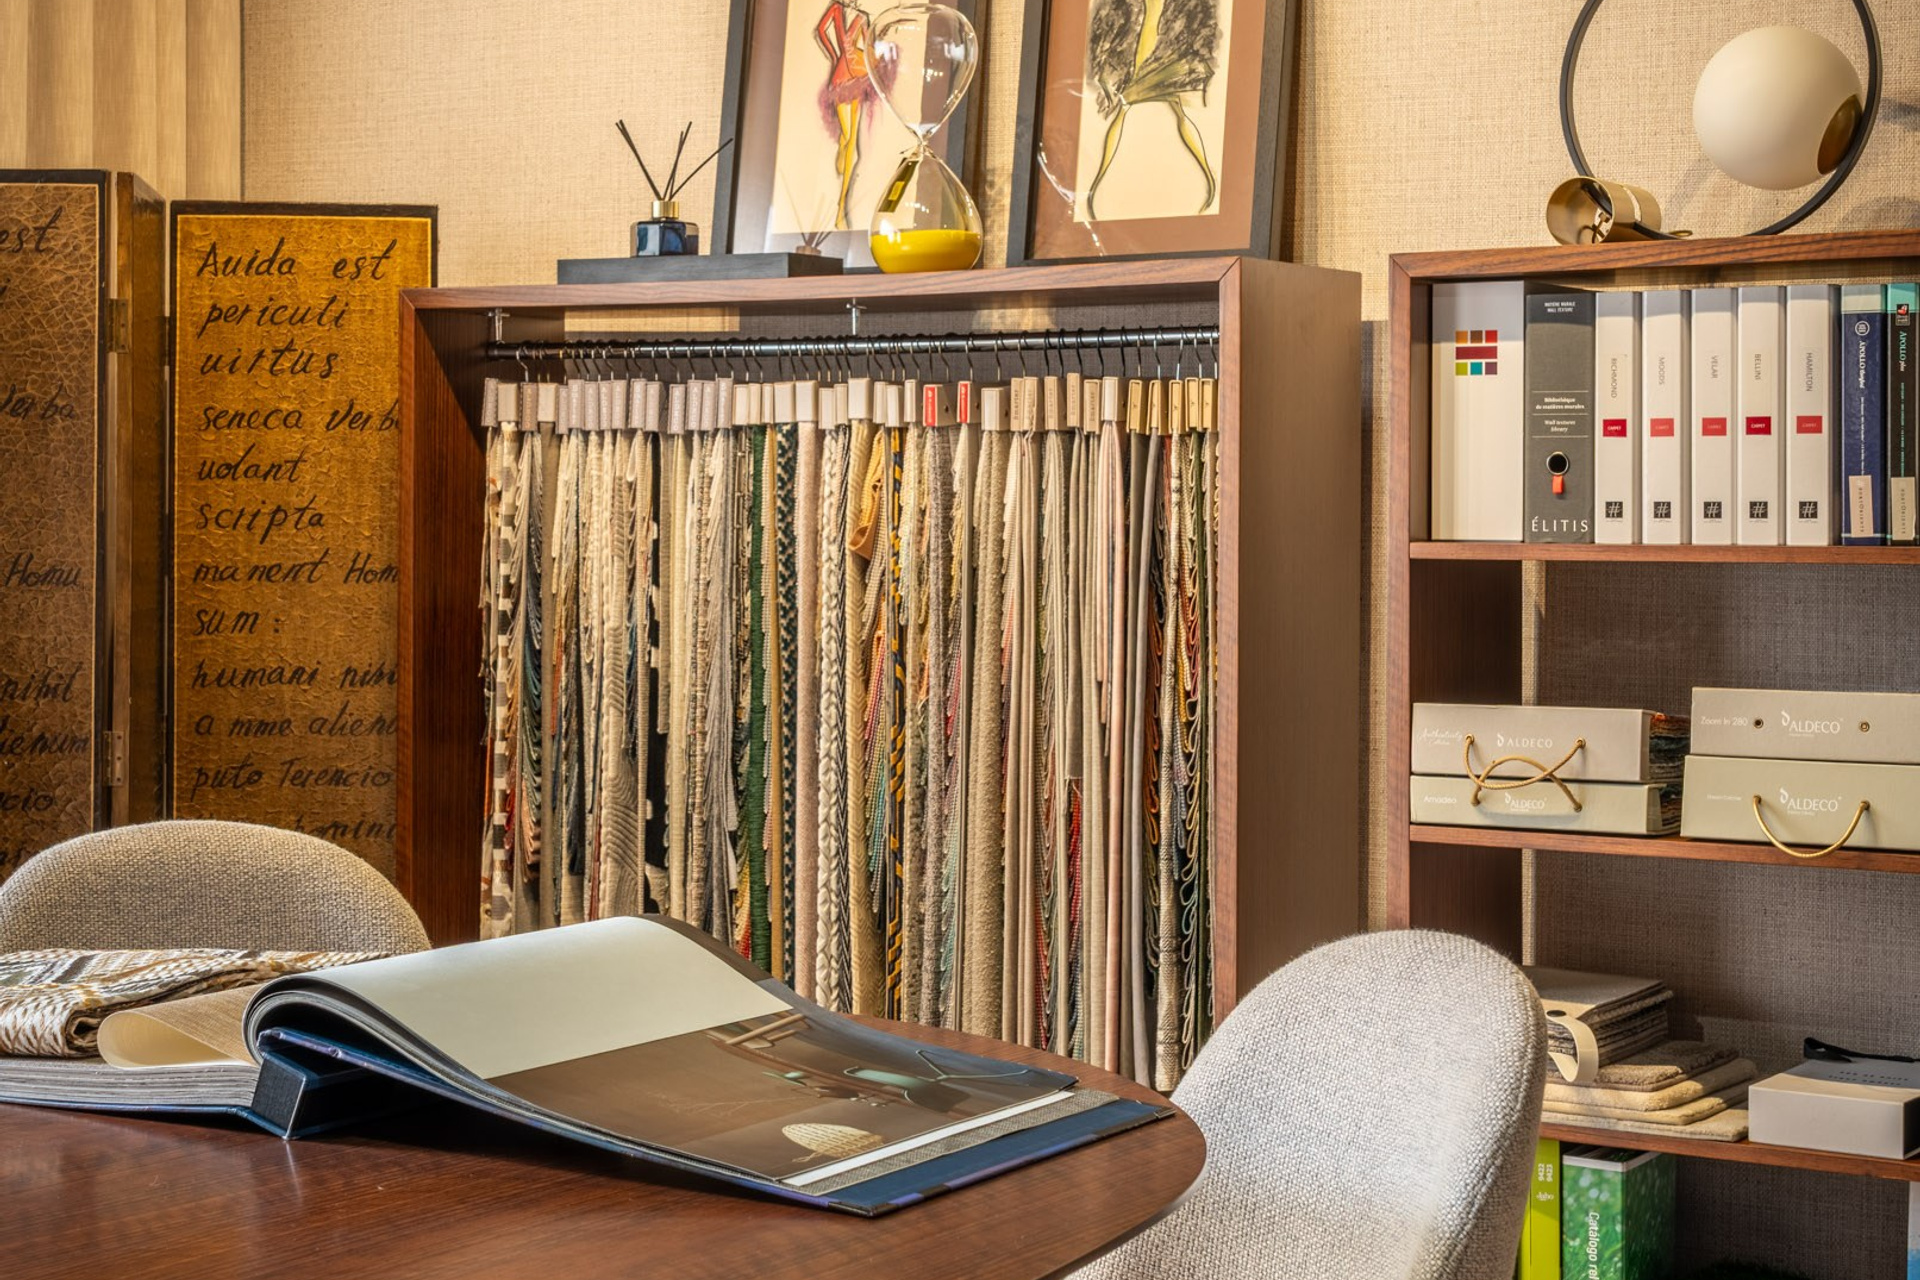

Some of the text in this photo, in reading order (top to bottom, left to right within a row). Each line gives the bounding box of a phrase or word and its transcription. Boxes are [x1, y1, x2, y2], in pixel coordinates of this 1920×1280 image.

[332, 238, 397, 280] est
[197, 295, 348, 340] periculi
[1805, 352, 1814, 392] HAMILTON
[1531, 515, 1589, 533] ÉLITIS
[1732, 717, 1749, 727] 280
[1789, 720, 1841, 734] ALDECO
[1507, 737, 1554, 749] ALDECO
[1509, 798, 1546, 810] ALDECO
[1787, 798, 1839, 812] ALDECO
